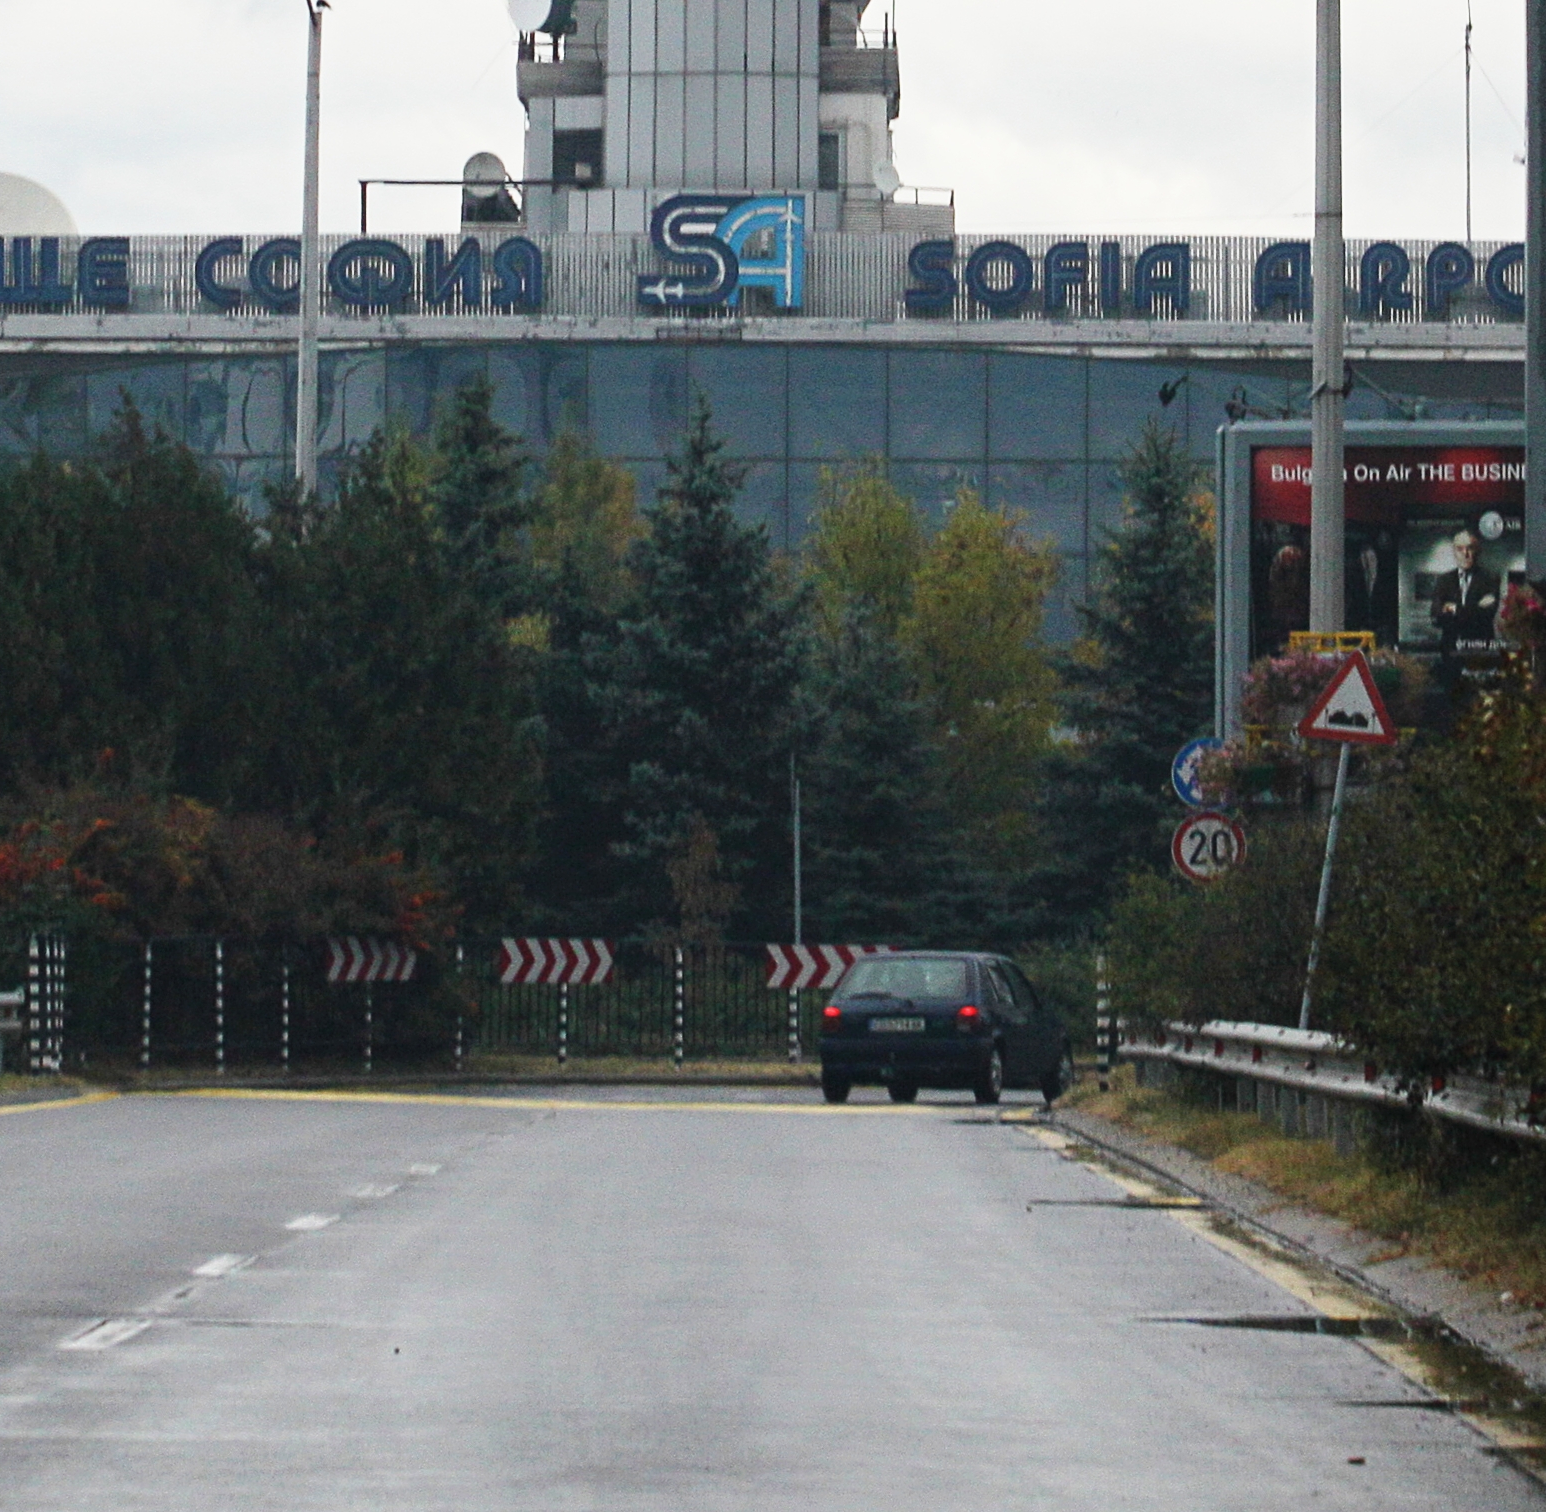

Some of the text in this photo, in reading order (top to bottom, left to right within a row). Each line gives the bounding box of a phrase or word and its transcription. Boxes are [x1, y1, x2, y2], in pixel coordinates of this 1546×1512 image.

[195, 236, 543, 307] СОФИЯ
[904, 240, 1525, 313] SOFIA ARPO
[1353, 463, 1380, 482] On
[1385, 463, 1412, 482] Air
[1417, 462, 1456, 482] THE
[1189, 829, 1233, 867] 20
